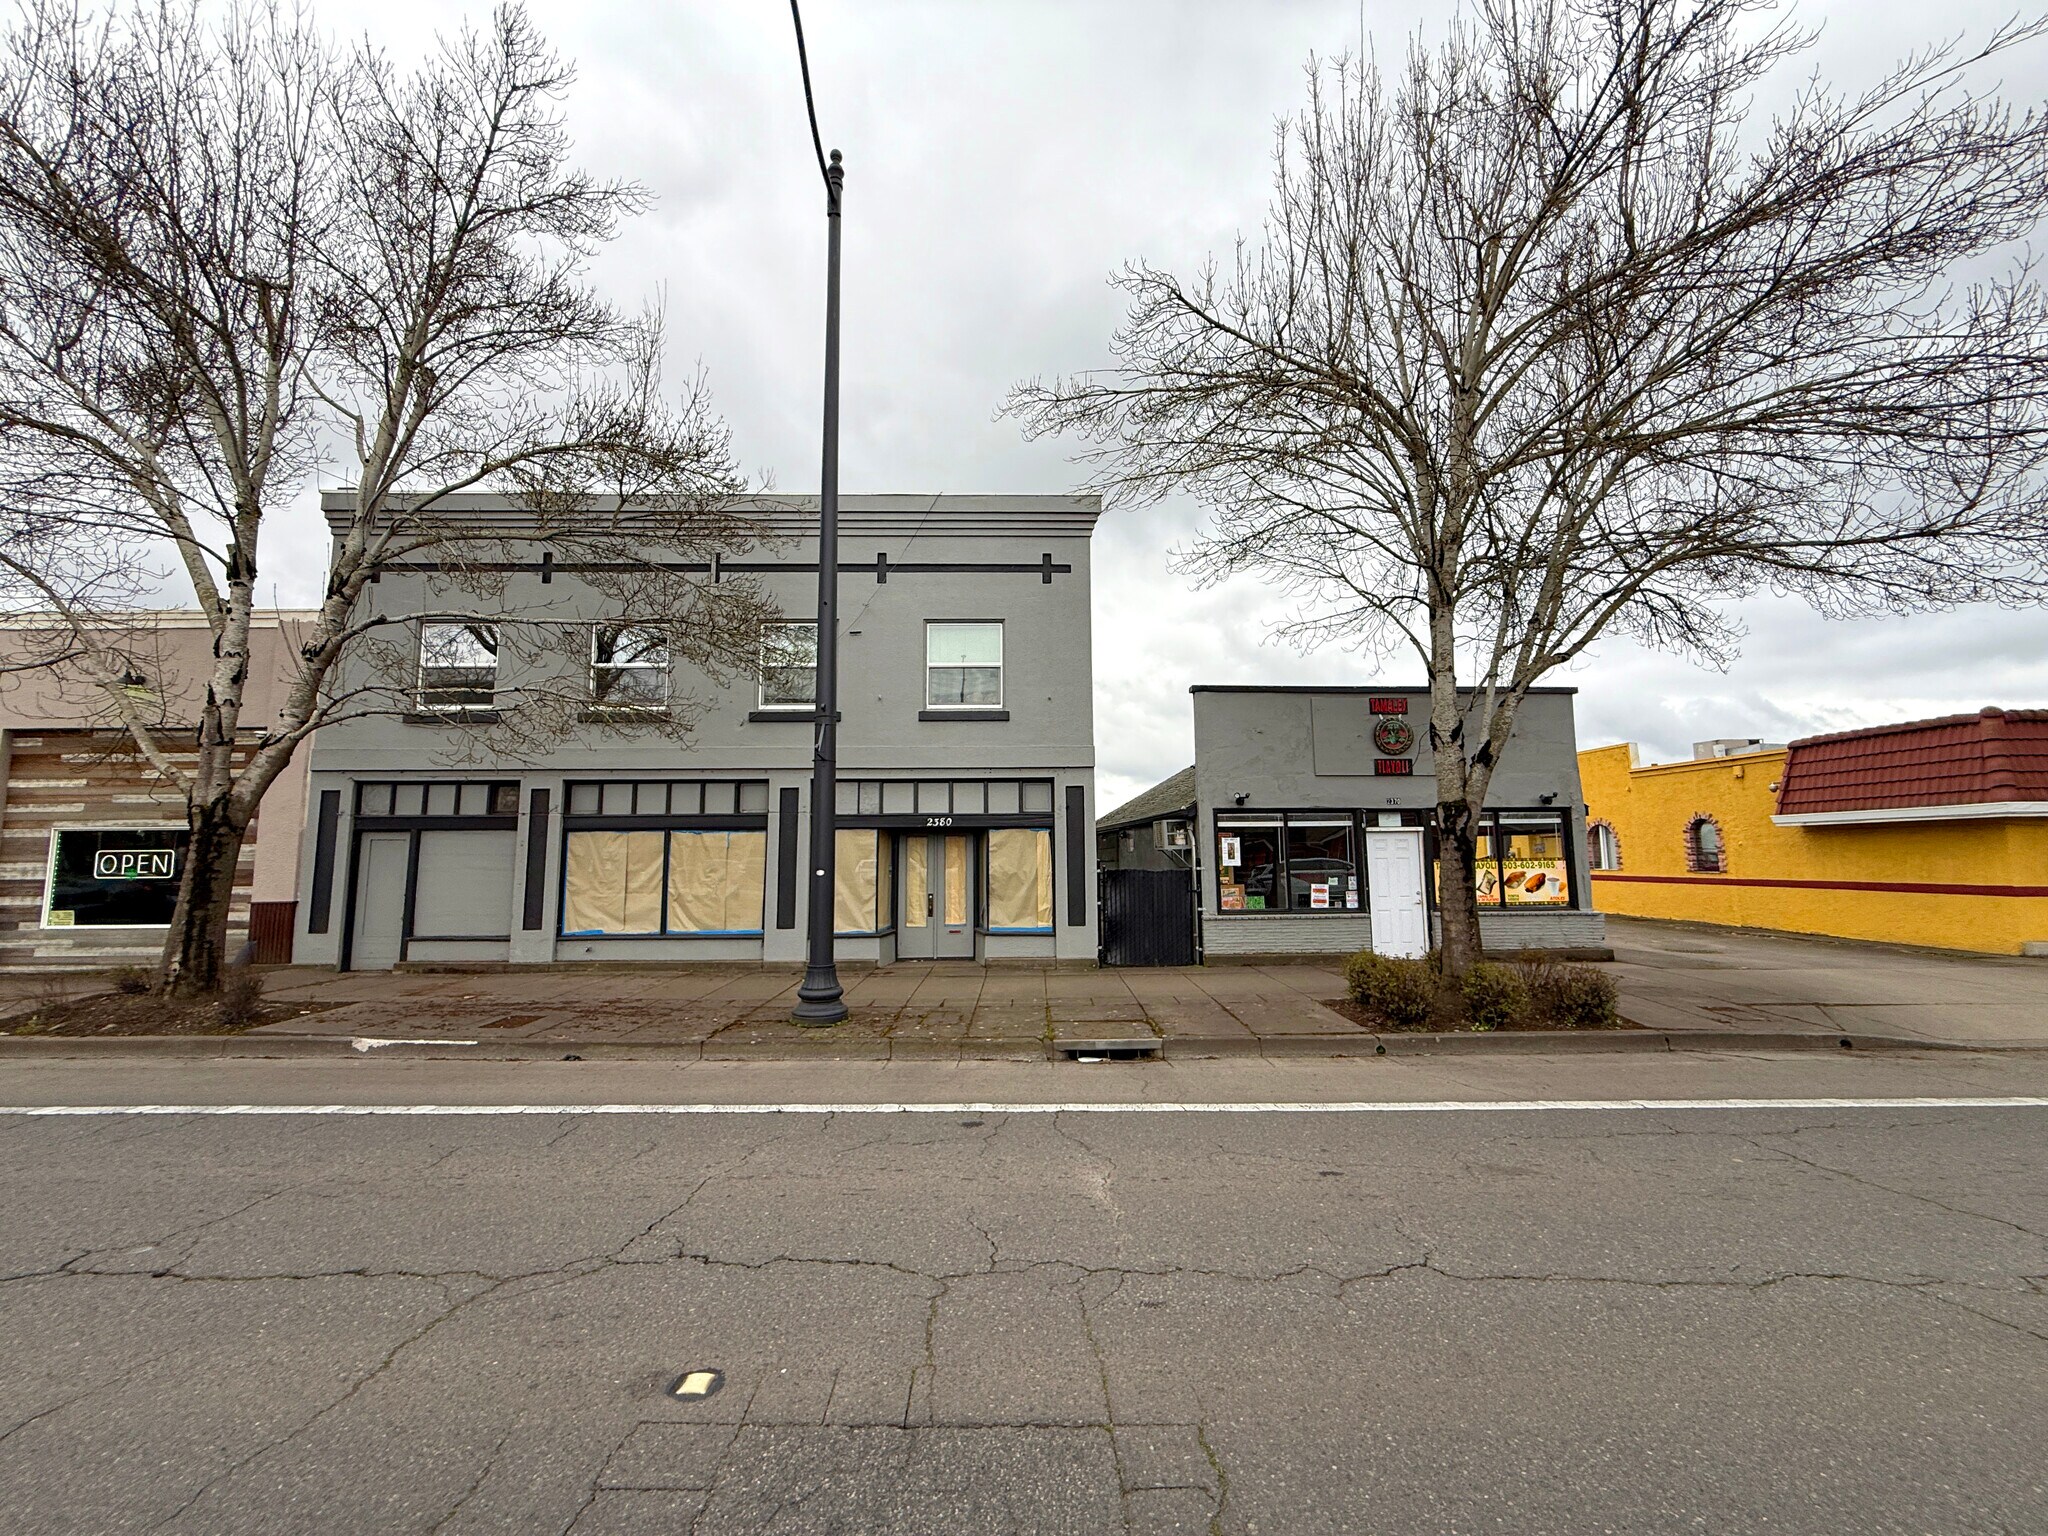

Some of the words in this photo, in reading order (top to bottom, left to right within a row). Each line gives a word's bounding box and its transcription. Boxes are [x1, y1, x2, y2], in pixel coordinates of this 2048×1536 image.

[1370, 699, 1407, 712] TAMALES
[1377, 760, 1409, 773] TLAYOLI
[926, 817, 953, 827] 2380
[100, 854, 169, 875] OPEN
[1503, 861, 1556, 870] 503-602-9165
